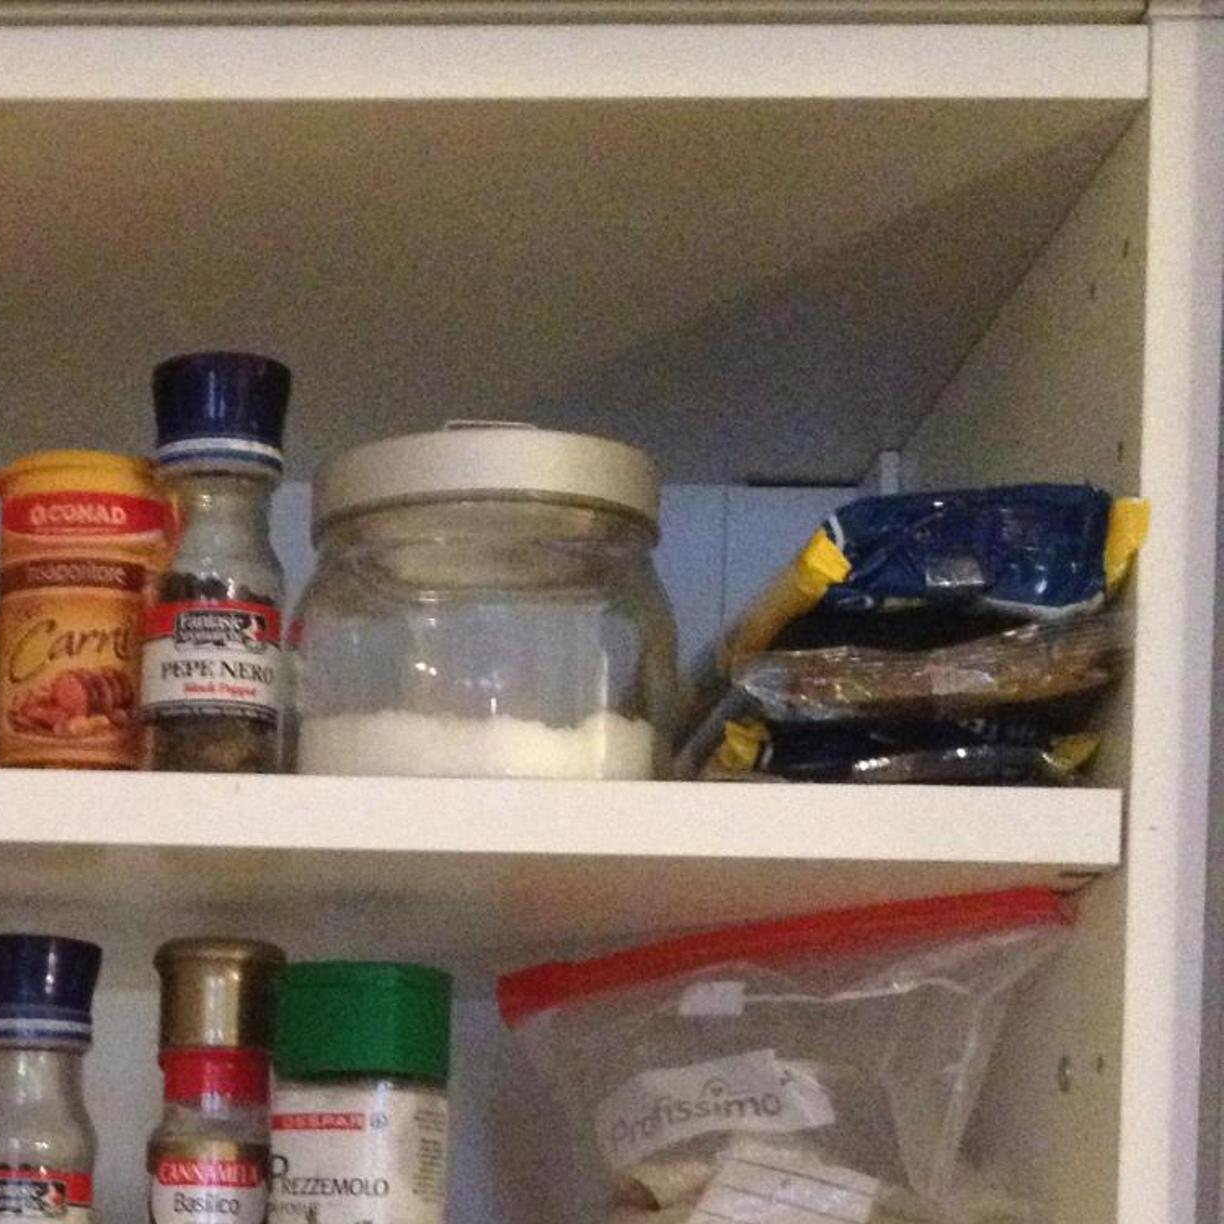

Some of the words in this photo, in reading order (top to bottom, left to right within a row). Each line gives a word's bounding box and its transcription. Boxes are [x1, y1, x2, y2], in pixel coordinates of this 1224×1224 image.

[48, 504, 127, 522] CONAD
[161, 660, 214, 680] PEPE
[220, 660, 275, 686] NERO
